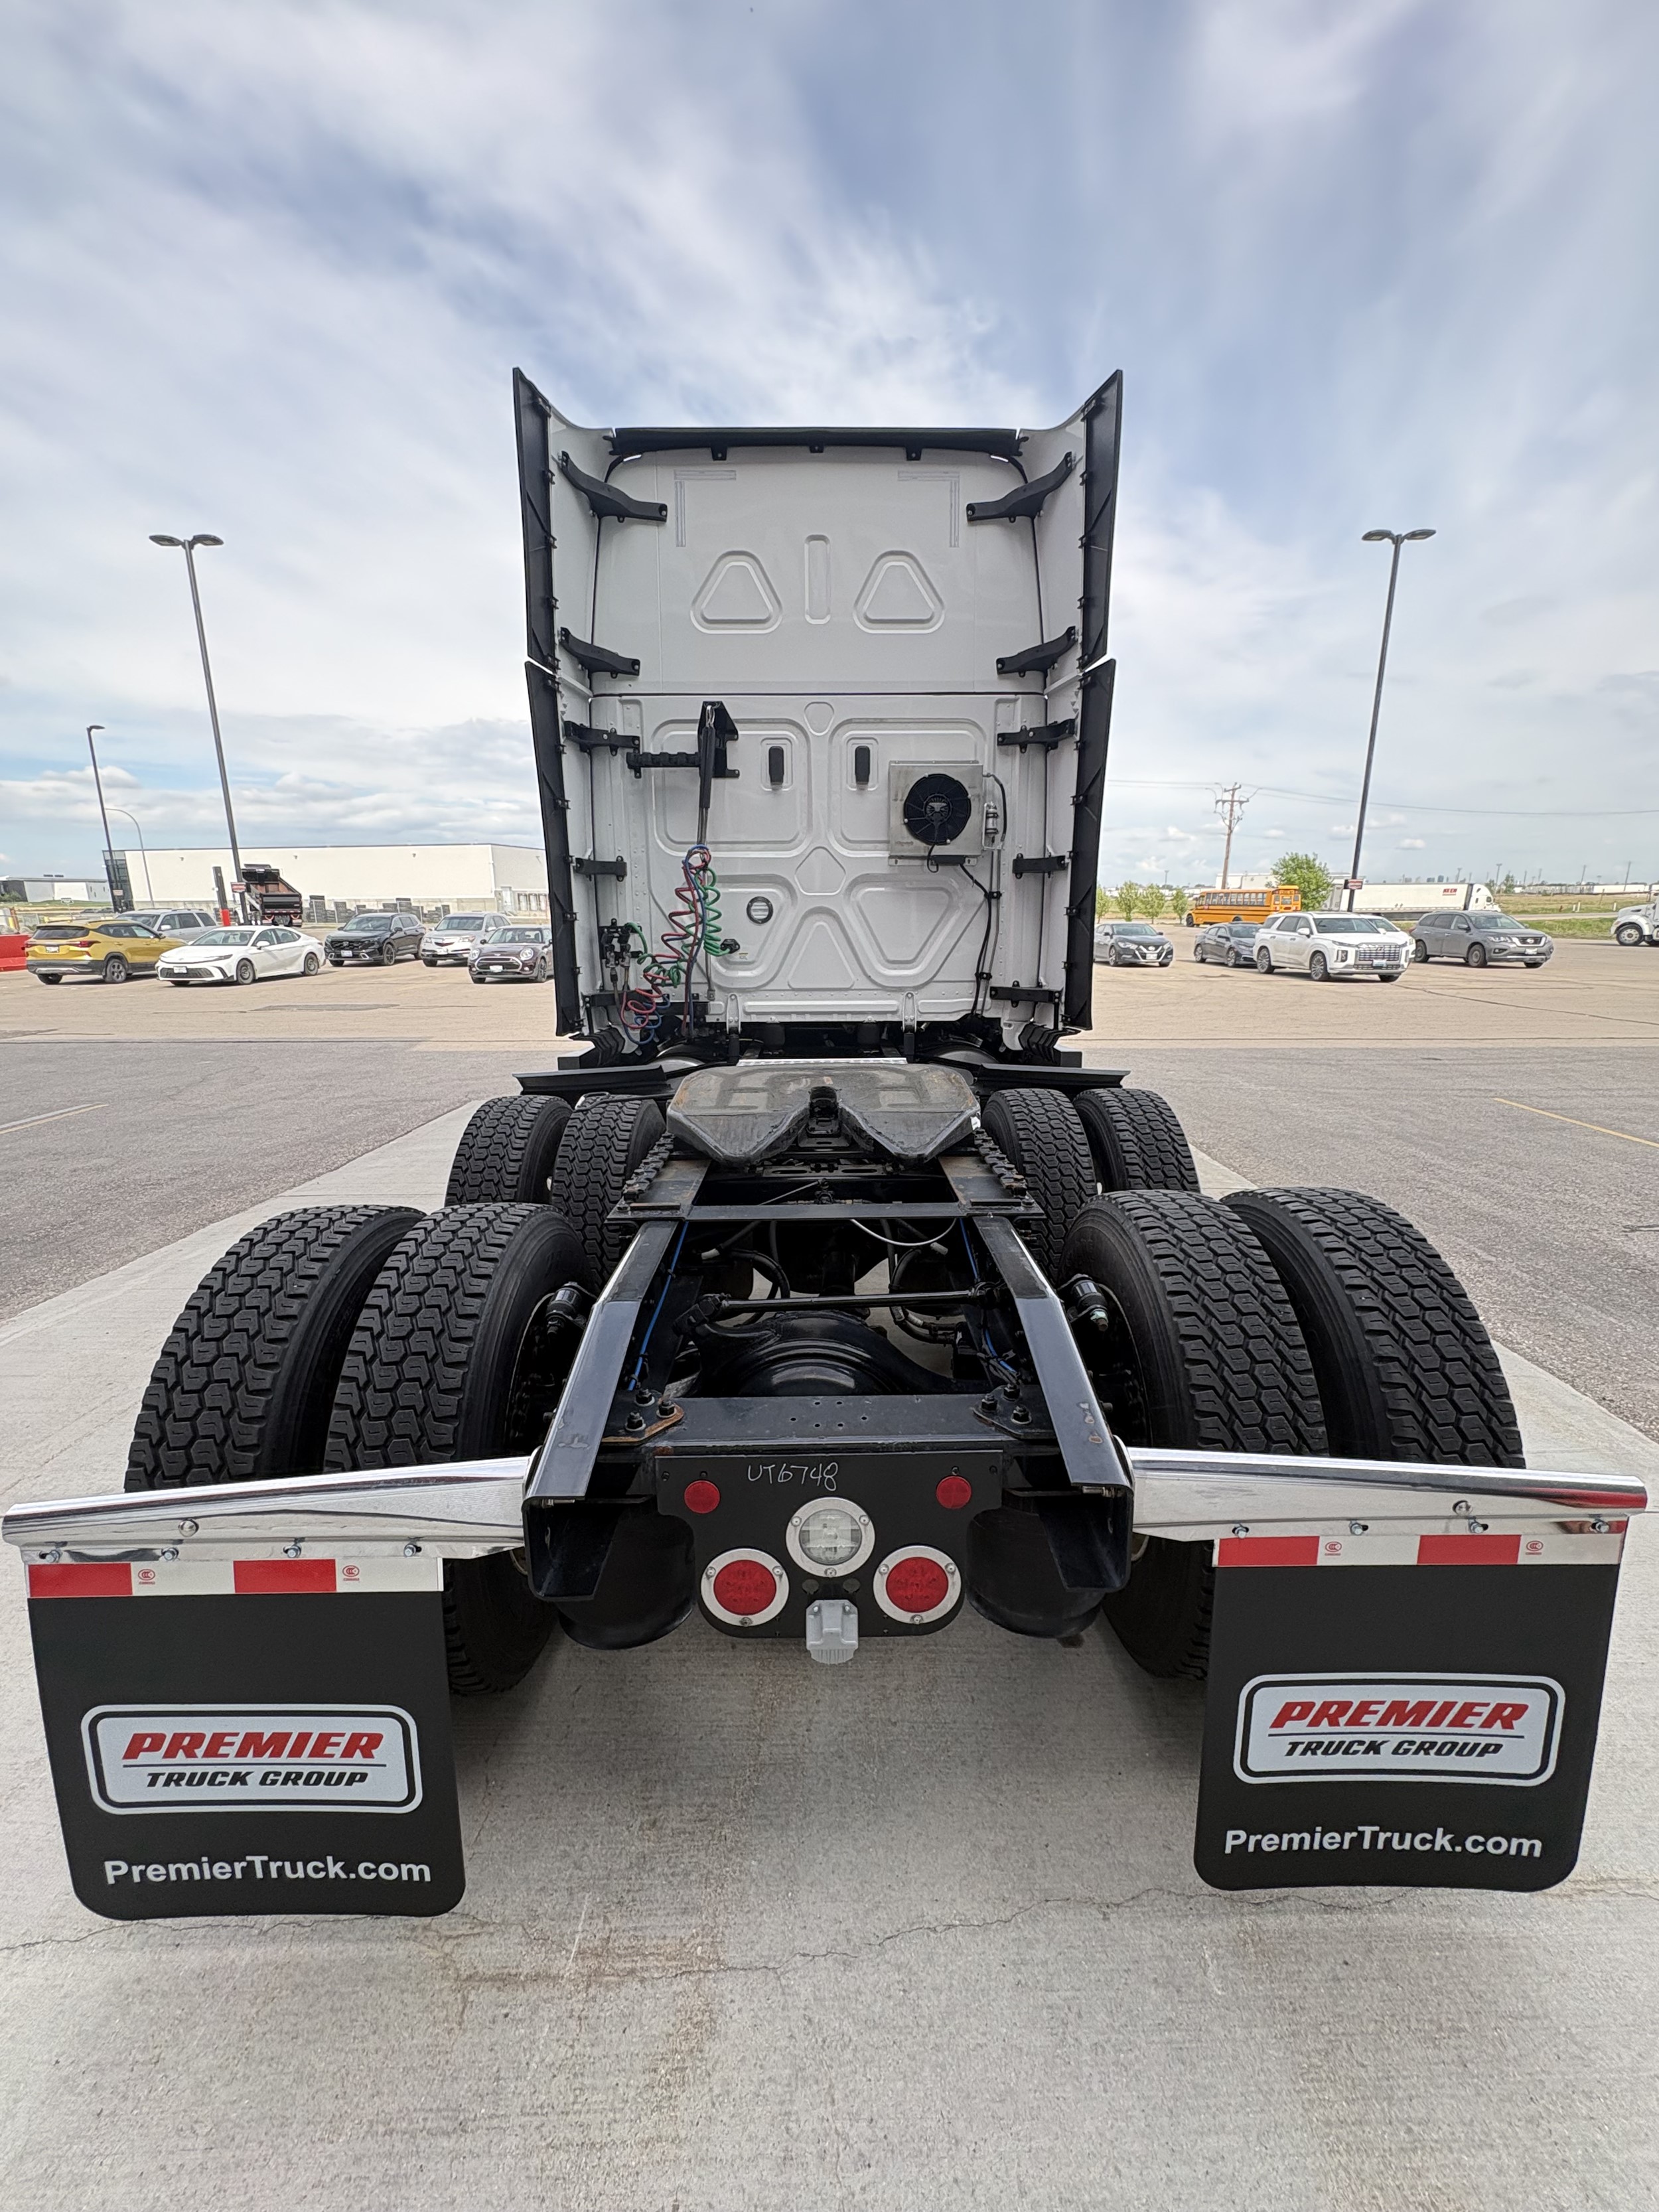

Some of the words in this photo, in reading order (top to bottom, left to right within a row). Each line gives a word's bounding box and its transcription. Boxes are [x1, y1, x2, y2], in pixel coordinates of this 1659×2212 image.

[748, 1462, 838, 1491] UT6748
[1269, 1700, 1528, 1730] PREMIER
[122, 1732, 383, 1760] PREMIER
[1284, 1739, 1390, 1757] TRUCK
[1391, 1739, 1504, 1757] GROUP
[147, 1771, 252, 1788] TRUCK
[258, 1771, 368, 1787] GROUP
[1224, 1826, 1542, 1858] PremierTruck.com
[104, 1856, 431, 1885] PremierTruck.com
